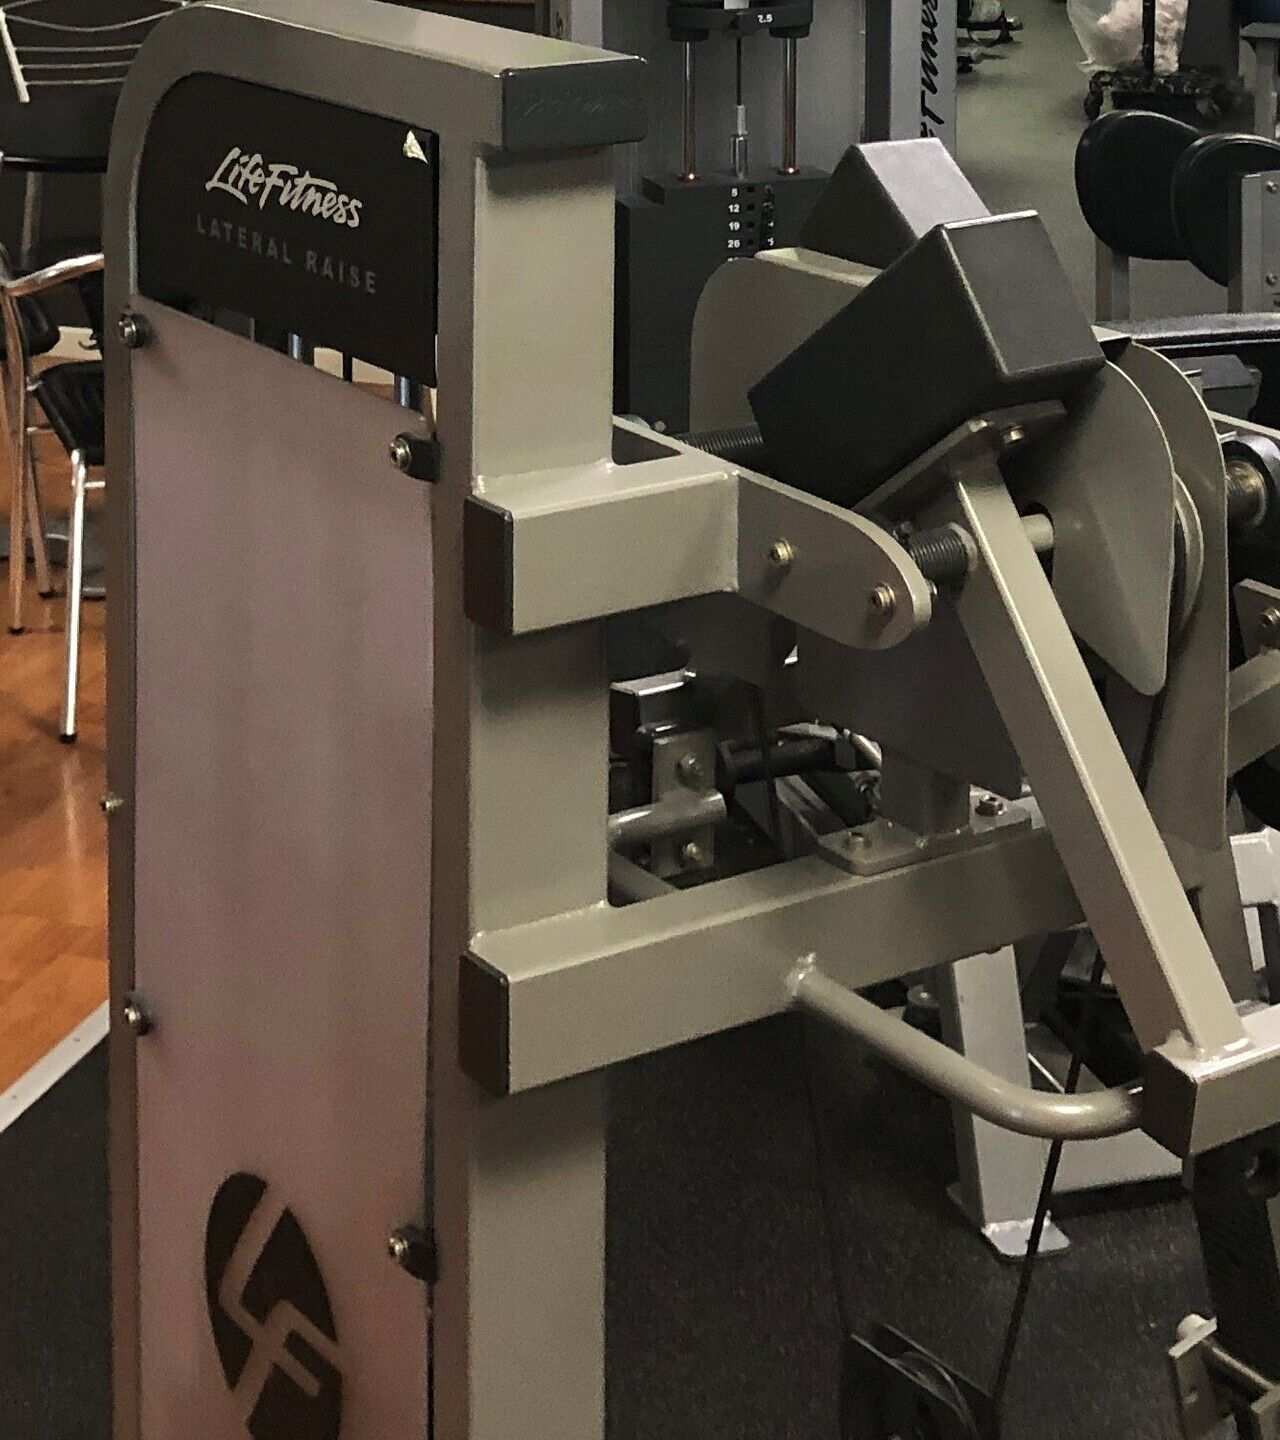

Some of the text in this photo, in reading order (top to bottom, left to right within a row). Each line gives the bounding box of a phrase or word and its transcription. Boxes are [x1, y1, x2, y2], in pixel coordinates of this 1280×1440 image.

[731, 188, 738, 197] 5
[728, 203, 740, 213] 12
[728, 221, 740, 231] 19
[727, 239, 740, 248] 26
[197, 213, 376, 295] LATERAL RAISE
